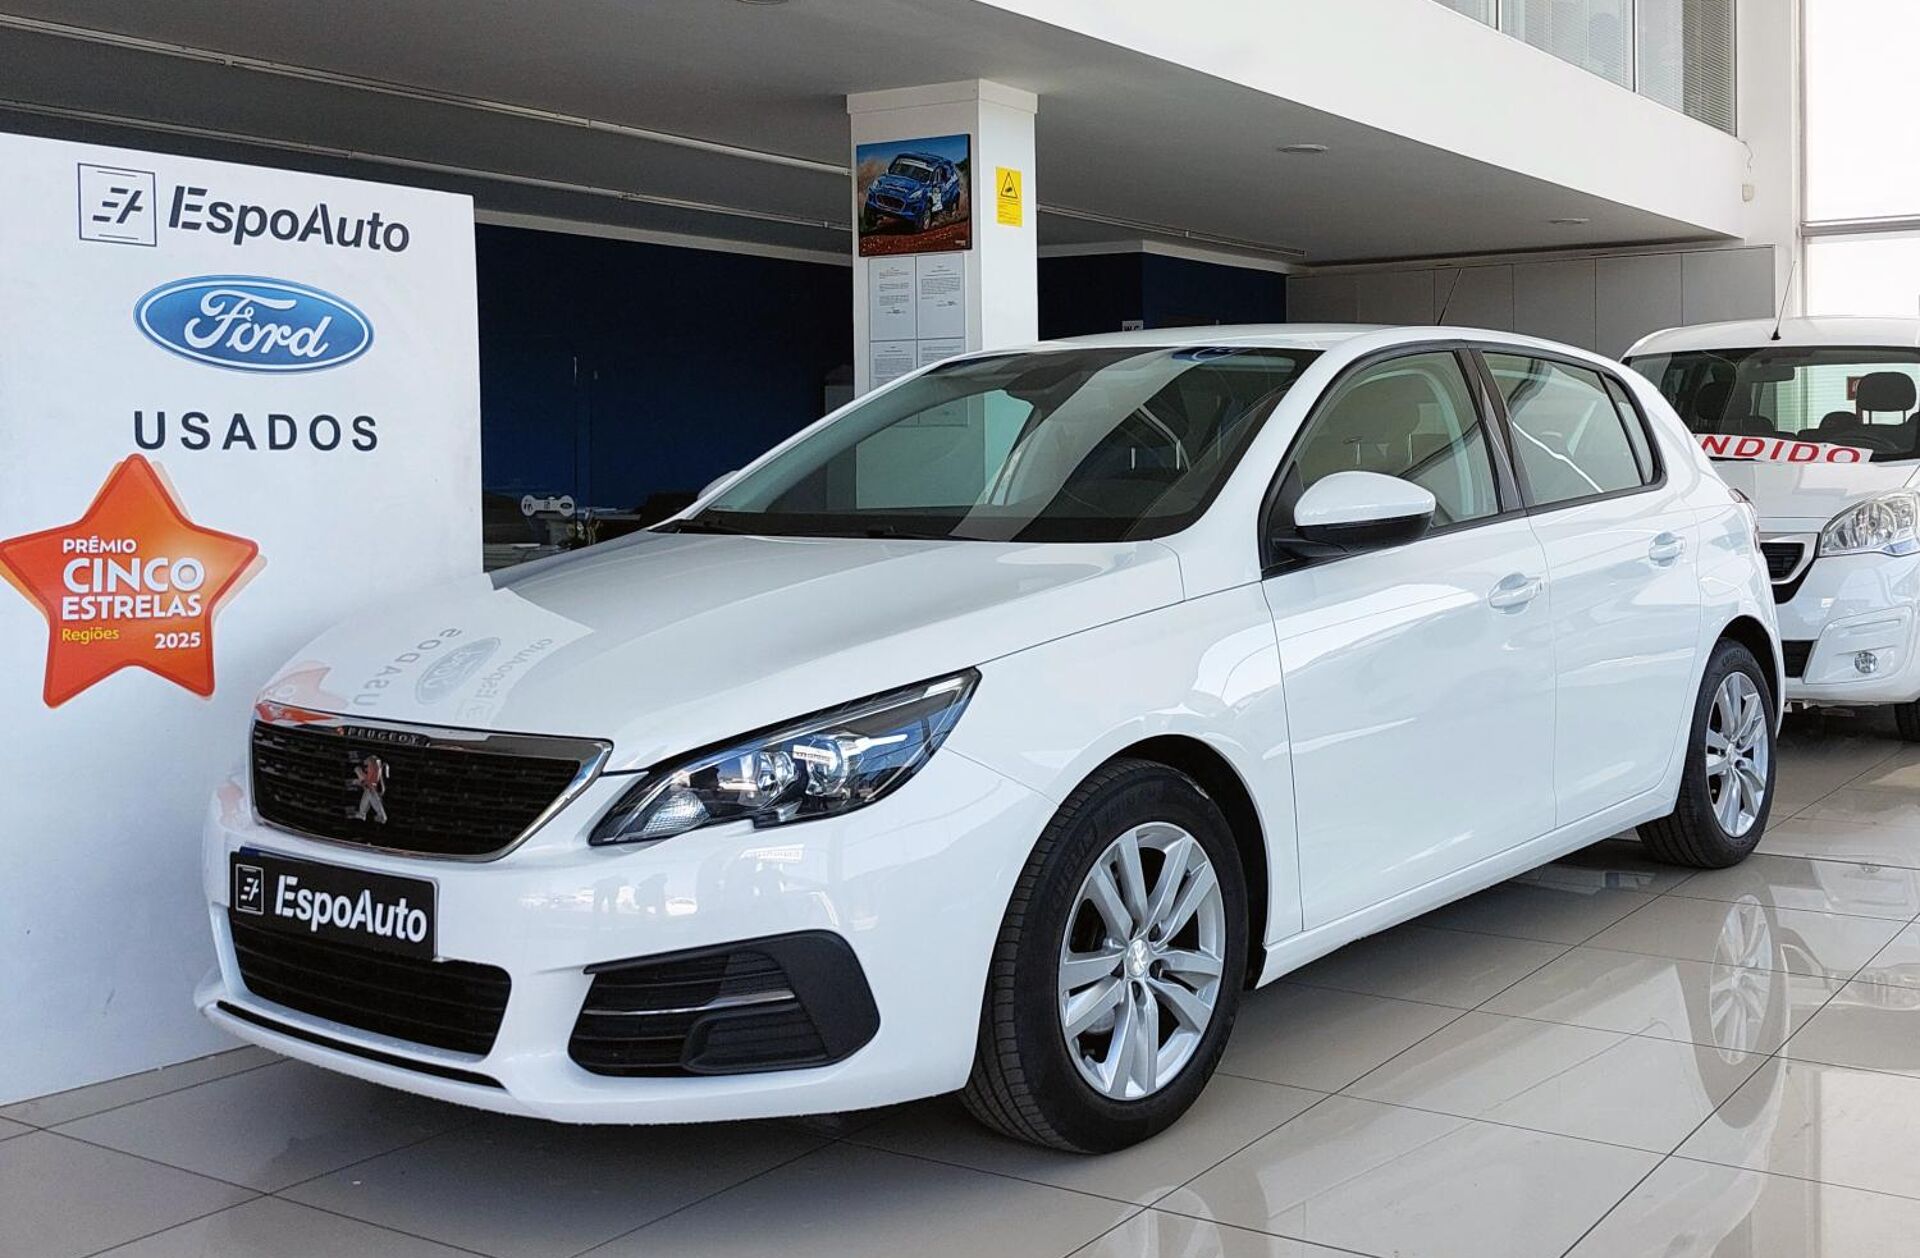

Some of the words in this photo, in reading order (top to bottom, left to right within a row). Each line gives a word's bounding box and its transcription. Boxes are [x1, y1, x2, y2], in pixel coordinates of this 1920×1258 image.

[168, 185, 410, 252] EspoAuto
[183, 288, 333, 358] Ford
[134, 410, 378, 451] USADOS
[1701, 435, 1861, 463] NDIDO
[62, 536, 137, 554] PRÉMIO
[62, 557, 205, 593] CINCO
[62, 594, 201, 620] ESTRELAS
[62, 627, 120, 645] Regiões
[154, 632, 201, 649] 2025
[347, 727, 419, 744] PEUGEOT
[275, 874, 427, 943] EspoAuto
